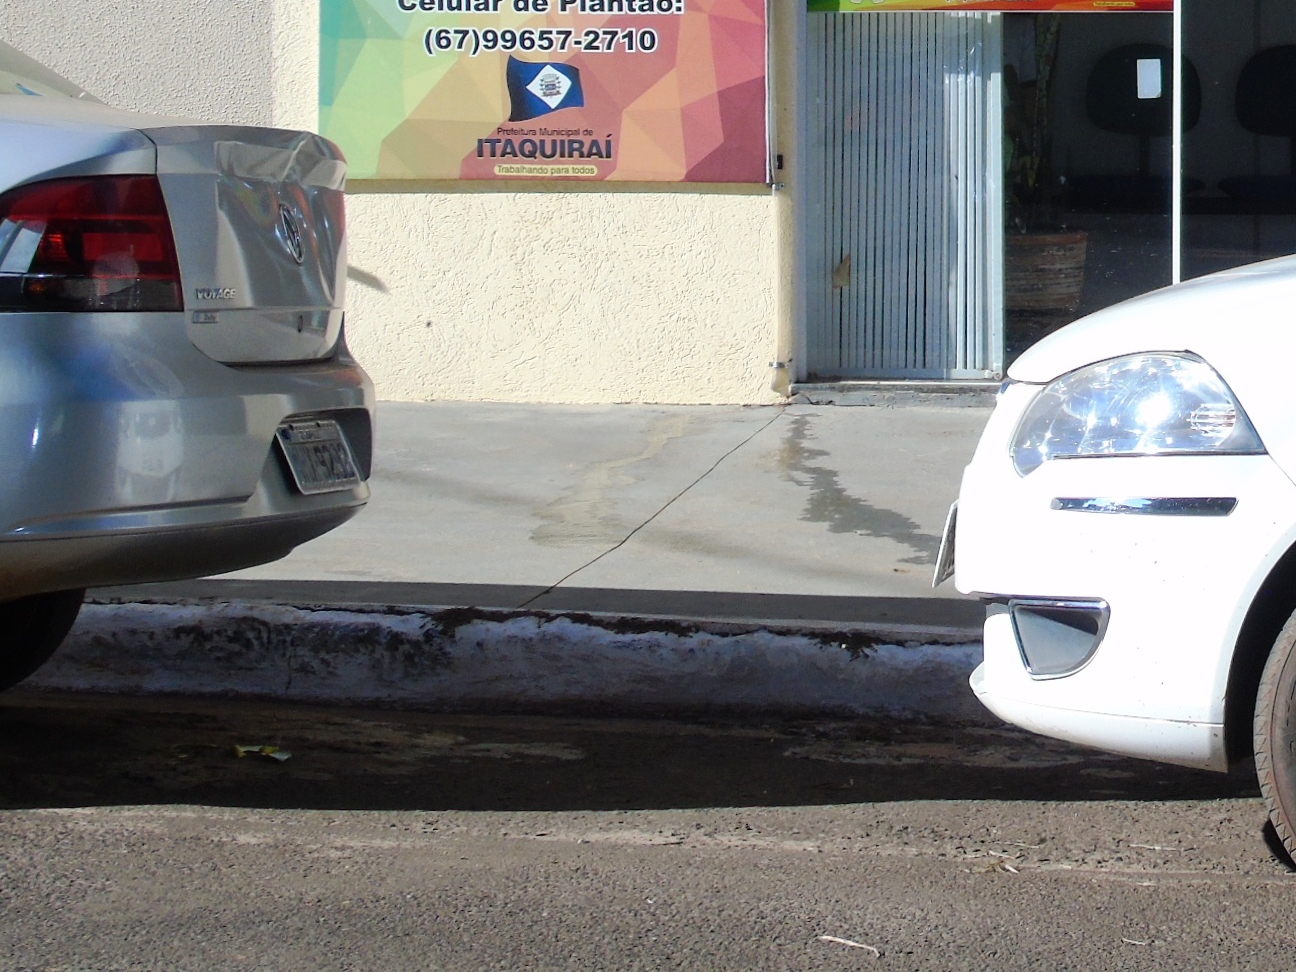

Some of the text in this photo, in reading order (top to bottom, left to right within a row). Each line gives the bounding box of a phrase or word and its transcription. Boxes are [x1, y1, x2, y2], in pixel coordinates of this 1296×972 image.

[424, 28, 656, 55] (67)99657-2710
[497, 127, 594, 138] Prefeitura Municipal de
[476, 133, 613, 160] ITAQUIRAÍ
[497, 164, 595, 176] Trabalhando para todos
[195, 287, 237, 301] VOYAGE
